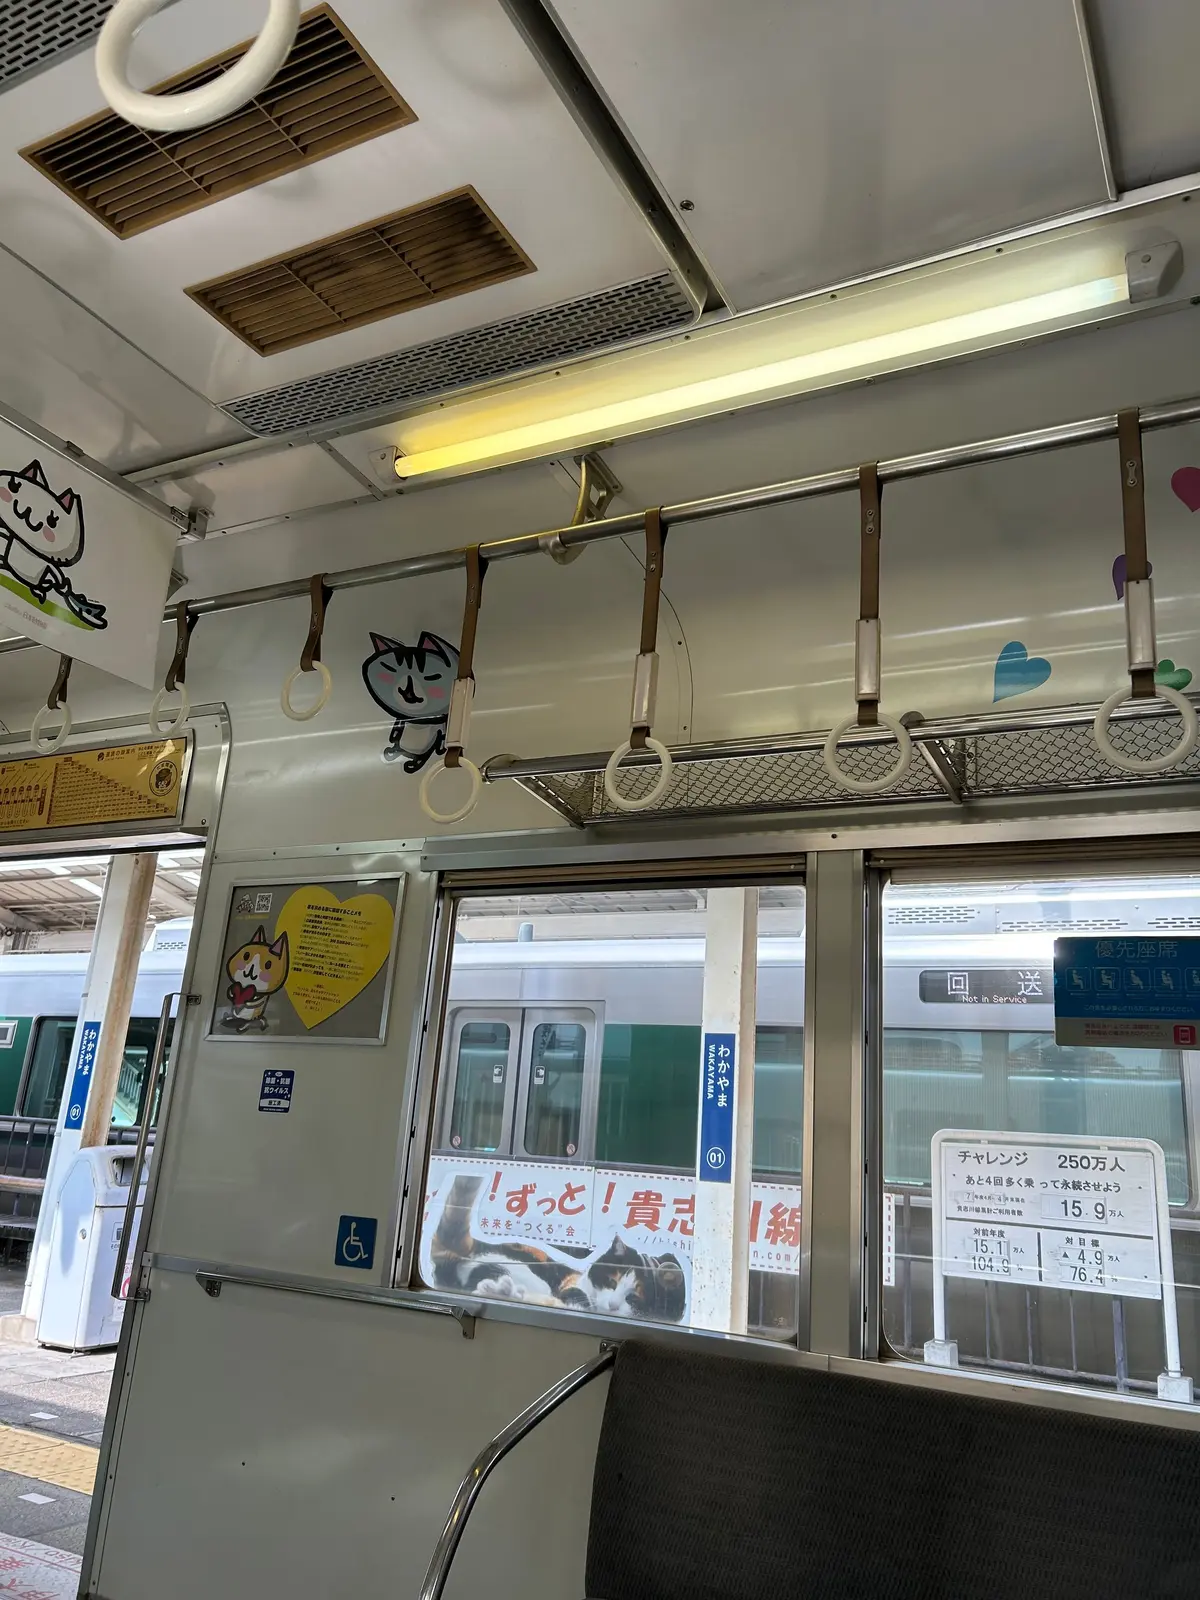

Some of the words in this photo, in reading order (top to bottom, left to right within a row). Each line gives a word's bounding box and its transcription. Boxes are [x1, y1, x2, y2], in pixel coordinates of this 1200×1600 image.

[1095, 940, 1178, 958] 優先座席
[947, 971, 1043, 996] 回送
[962, 994, 978, 1004] Not
[981, 994, 989, 1003] in
[992, 994, 1028, 1004] Service
[77, 1029, 90, 1070] WAKAYAMA
[82, 1029, 97, 1076] わかやま
[706, 1044, 716, 1100] WAKAYAMA
[716, 1044, 731, 1107] わかやま
[709, 1152, 722, 1164] 01
[957, 1150, 1029, 1167] チャレンジ
[1057, 1154, 1126, 1173] 250万人
[1060, 1199, 1106, 1220] 15.9
[1108, 1209, 1125, 1218] 万人
[973, 1227, 1006, 1239] 対前年度
[972, 1238, 1004, 1256] 15.1
[1012, 1246, 1025, 1254] 万人
[971, 1255, 1010, 1273] 104.9
[1107, 1255, 1121, 1263] 万人
[1070, 1265, 1103, 1284] 76.4
